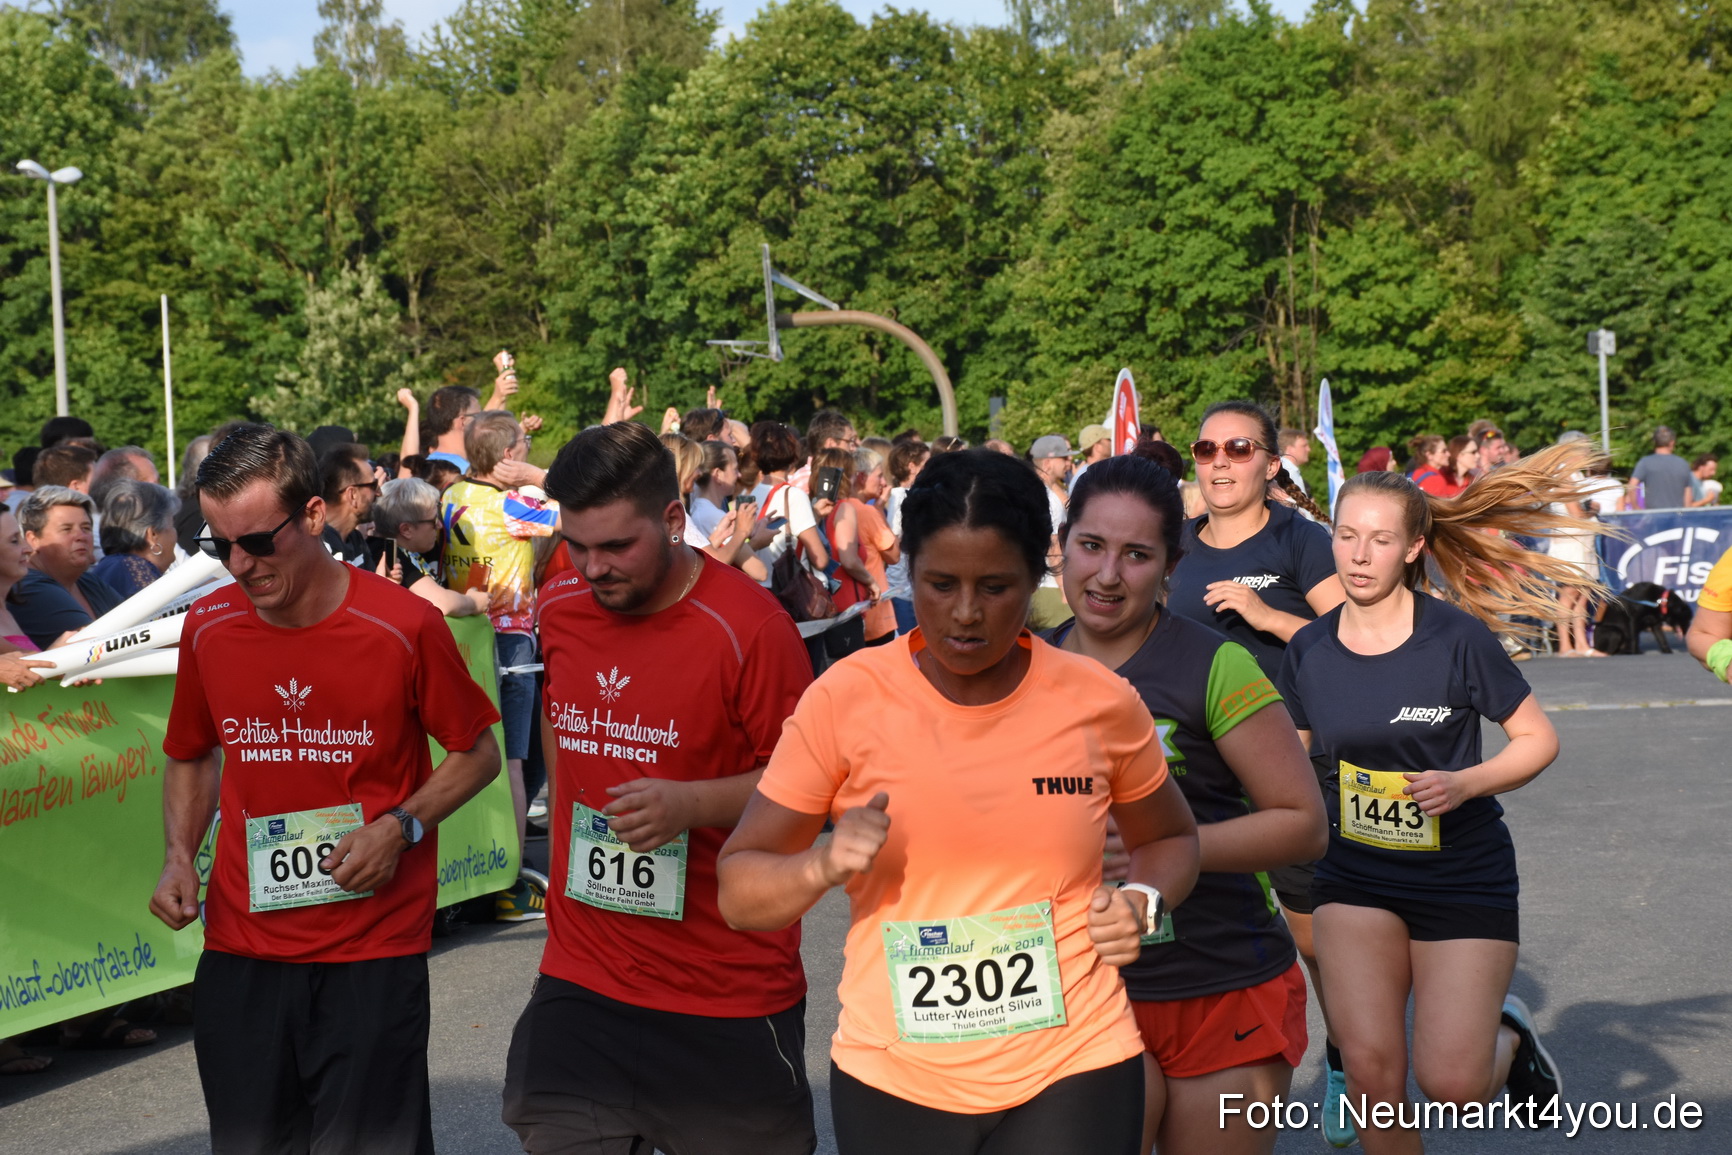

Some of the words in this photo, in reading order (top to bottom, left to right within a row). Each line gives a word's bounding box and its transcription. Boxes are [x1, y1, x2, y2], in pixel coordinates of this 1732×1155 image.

[557, 577, 579, 587] JAKO
[207, 602, 230, 612] JAKO
[37, 700, 119, 745] Firmen
[551, 702, 590, 733] Echtes
[591, 708, 680, 748] Handwerk
[1389, 706, 1438, 724] JURA
[222, 717, 280, 745] Echtes
[281, 717, 375, 746] Handwerk
[240, 749, 293, 763] IMMER
[298, 748, 353, 763] FRISCH
[559, 735, 599, 756] IMMER
[603, 743, 657, 764] FRISCH
[0, 765, 73, 828] laufen
[80, 728, 157, 804] länger!
[1032, 776, 1094, 795] THULE
[1350, 793, 1424, 830] 1443
[262, 829, 304, 844] firmenlauf
[1351, 820, 1394, 836] Schöffmann
[1396, 829, 1424, 839] Teresa
[655, 847, 679, 857] 2019
[270, 842, 336, 883] 608
[588, 846, 655, 889] 616
[263, 882, 300, 895] Ruchser
[301, 879, 337, 891] Maxim
[586, 879, 617, 894] Söllner
[618, 887, 655, 900] Daniele
[585, 889, 595, 897] Der
[595, 891, 616, 902] Bäcker
[634, 899, 656, 908] GmbH
[910, 940, 975, 956] firmenlauf
[991, 944, 1011, 955] run
[1015, 936, 1044, 951] 2019
[0, 932, 156, 1011] nlauf-oberpfalz.de
[908, 952, 1038, 1008] 2302
[914, 1004, 1005, 1022] Lutter-Weinert
[1008, 997, 1043, 1012] Silvia
[952, 1020, 976, 1031] Thule
[979, 1016, 1006, 1028] GmbH
